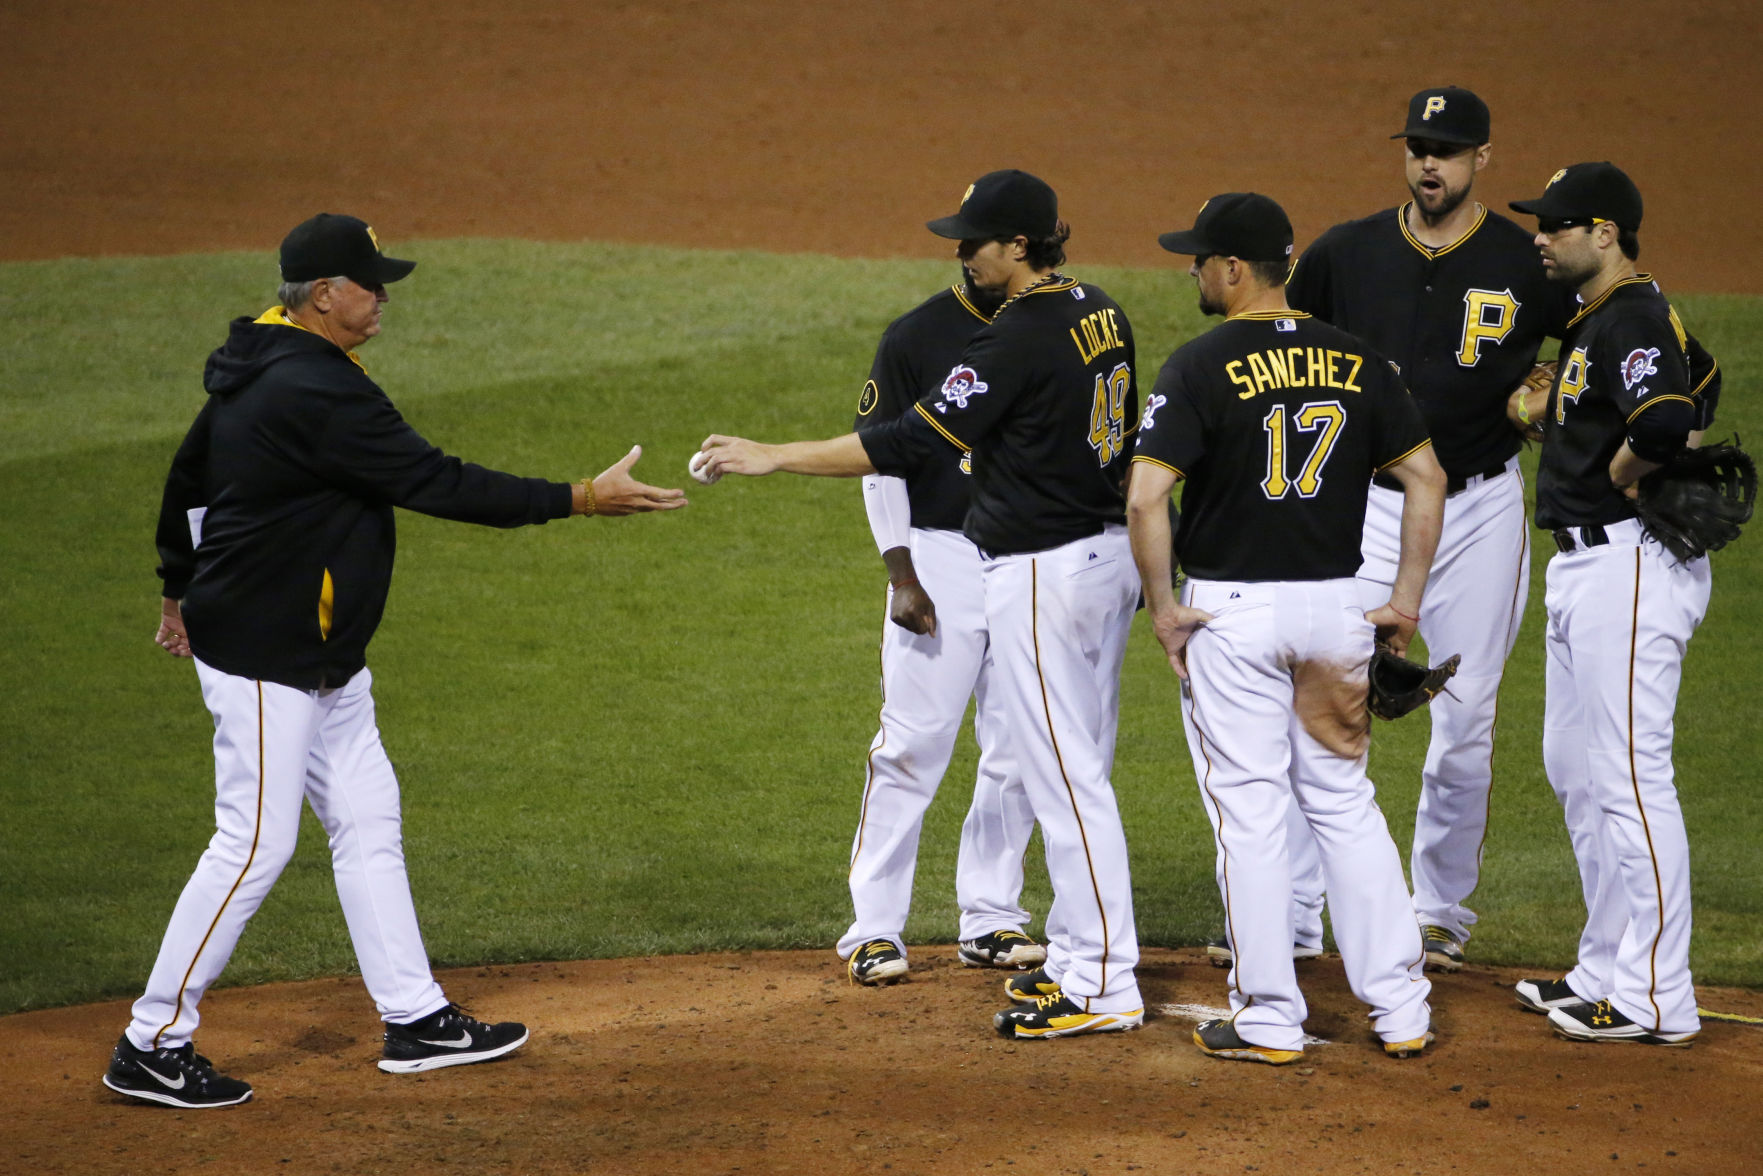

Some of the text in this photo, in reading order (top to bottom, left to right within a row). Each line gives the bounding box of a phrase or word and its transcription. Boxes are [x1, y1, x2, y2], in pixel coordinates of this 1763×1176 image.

[1422, 95, 1447, 120] P
[1069, 308, 1125, 366] LOCKE
[1455, 287, 1522, 368] P
[1225, 346, 1364, 400] SANCHEZ
[1556, 346, 1593, 426] P
[1087, 361, 1131, 468] 49
[1260, 400, 1347, 500] 17
